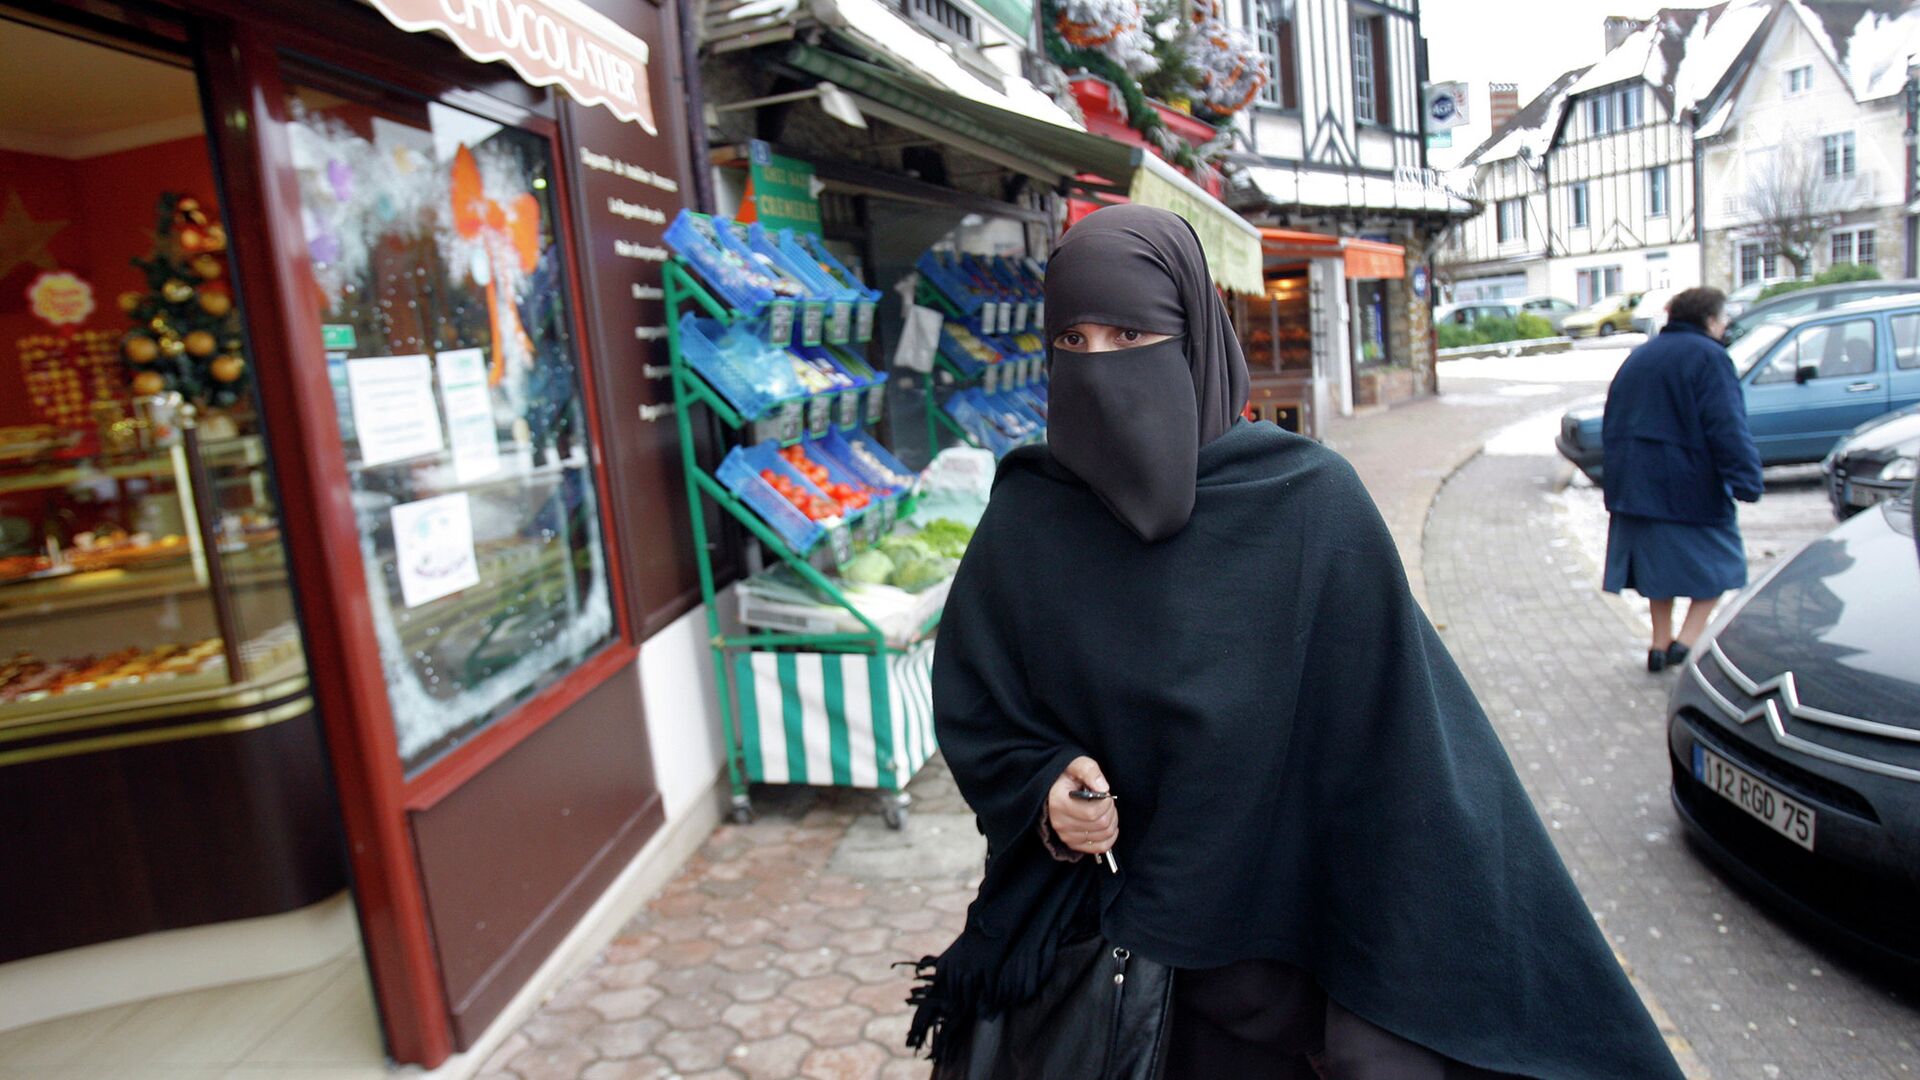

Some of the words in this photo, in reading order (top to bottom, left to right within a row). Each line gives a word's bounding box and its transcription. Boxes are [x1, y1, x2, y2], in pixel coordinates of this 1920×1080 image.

[1705, 756, 1735, 798] 112
[1740, 776, 1775, 821] RGD
[1782, 800, 1810, 842] 75
